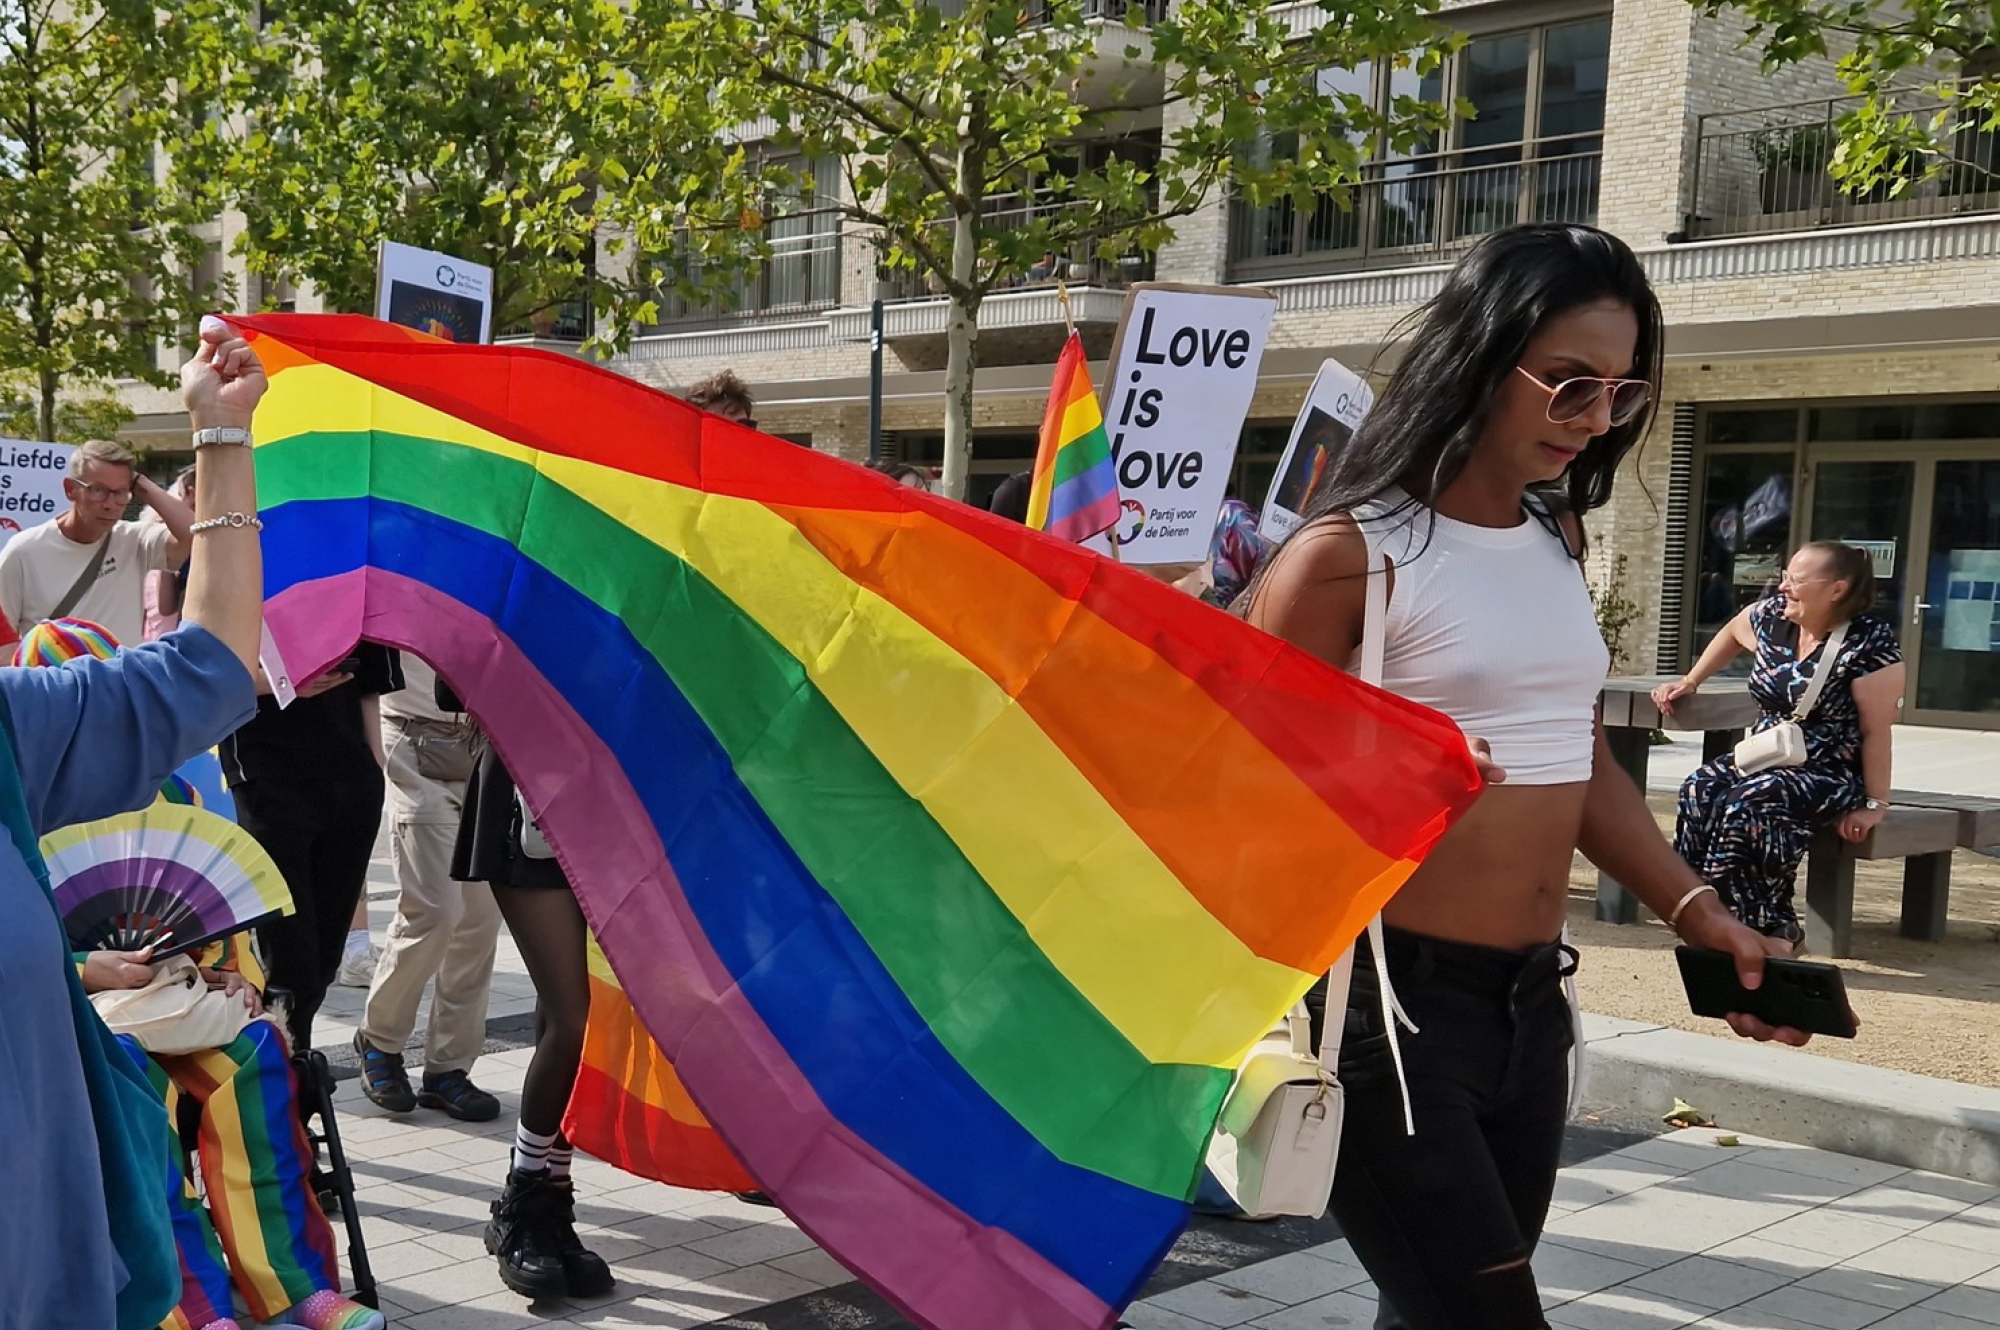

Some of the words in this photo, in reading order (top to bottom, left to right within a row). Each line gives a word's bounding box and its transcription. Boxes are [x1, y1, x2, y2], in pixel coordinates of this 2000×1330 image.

[1135, 307, 1250, 369] Love
[1119, 370, 1163, 428] is
[0, 446, 66, 470] Liefde
[1112, 433, 1203, 489] love
[0, 474, 12, 489] s
[0, 490, 55, 513] iefde
[1150, 508, 1175, 522] Partij
[1177, 510, 1197, 519] voor
[1145, 526, 1158, 538] de
[1159, 525, 1190, 538] Dieren
